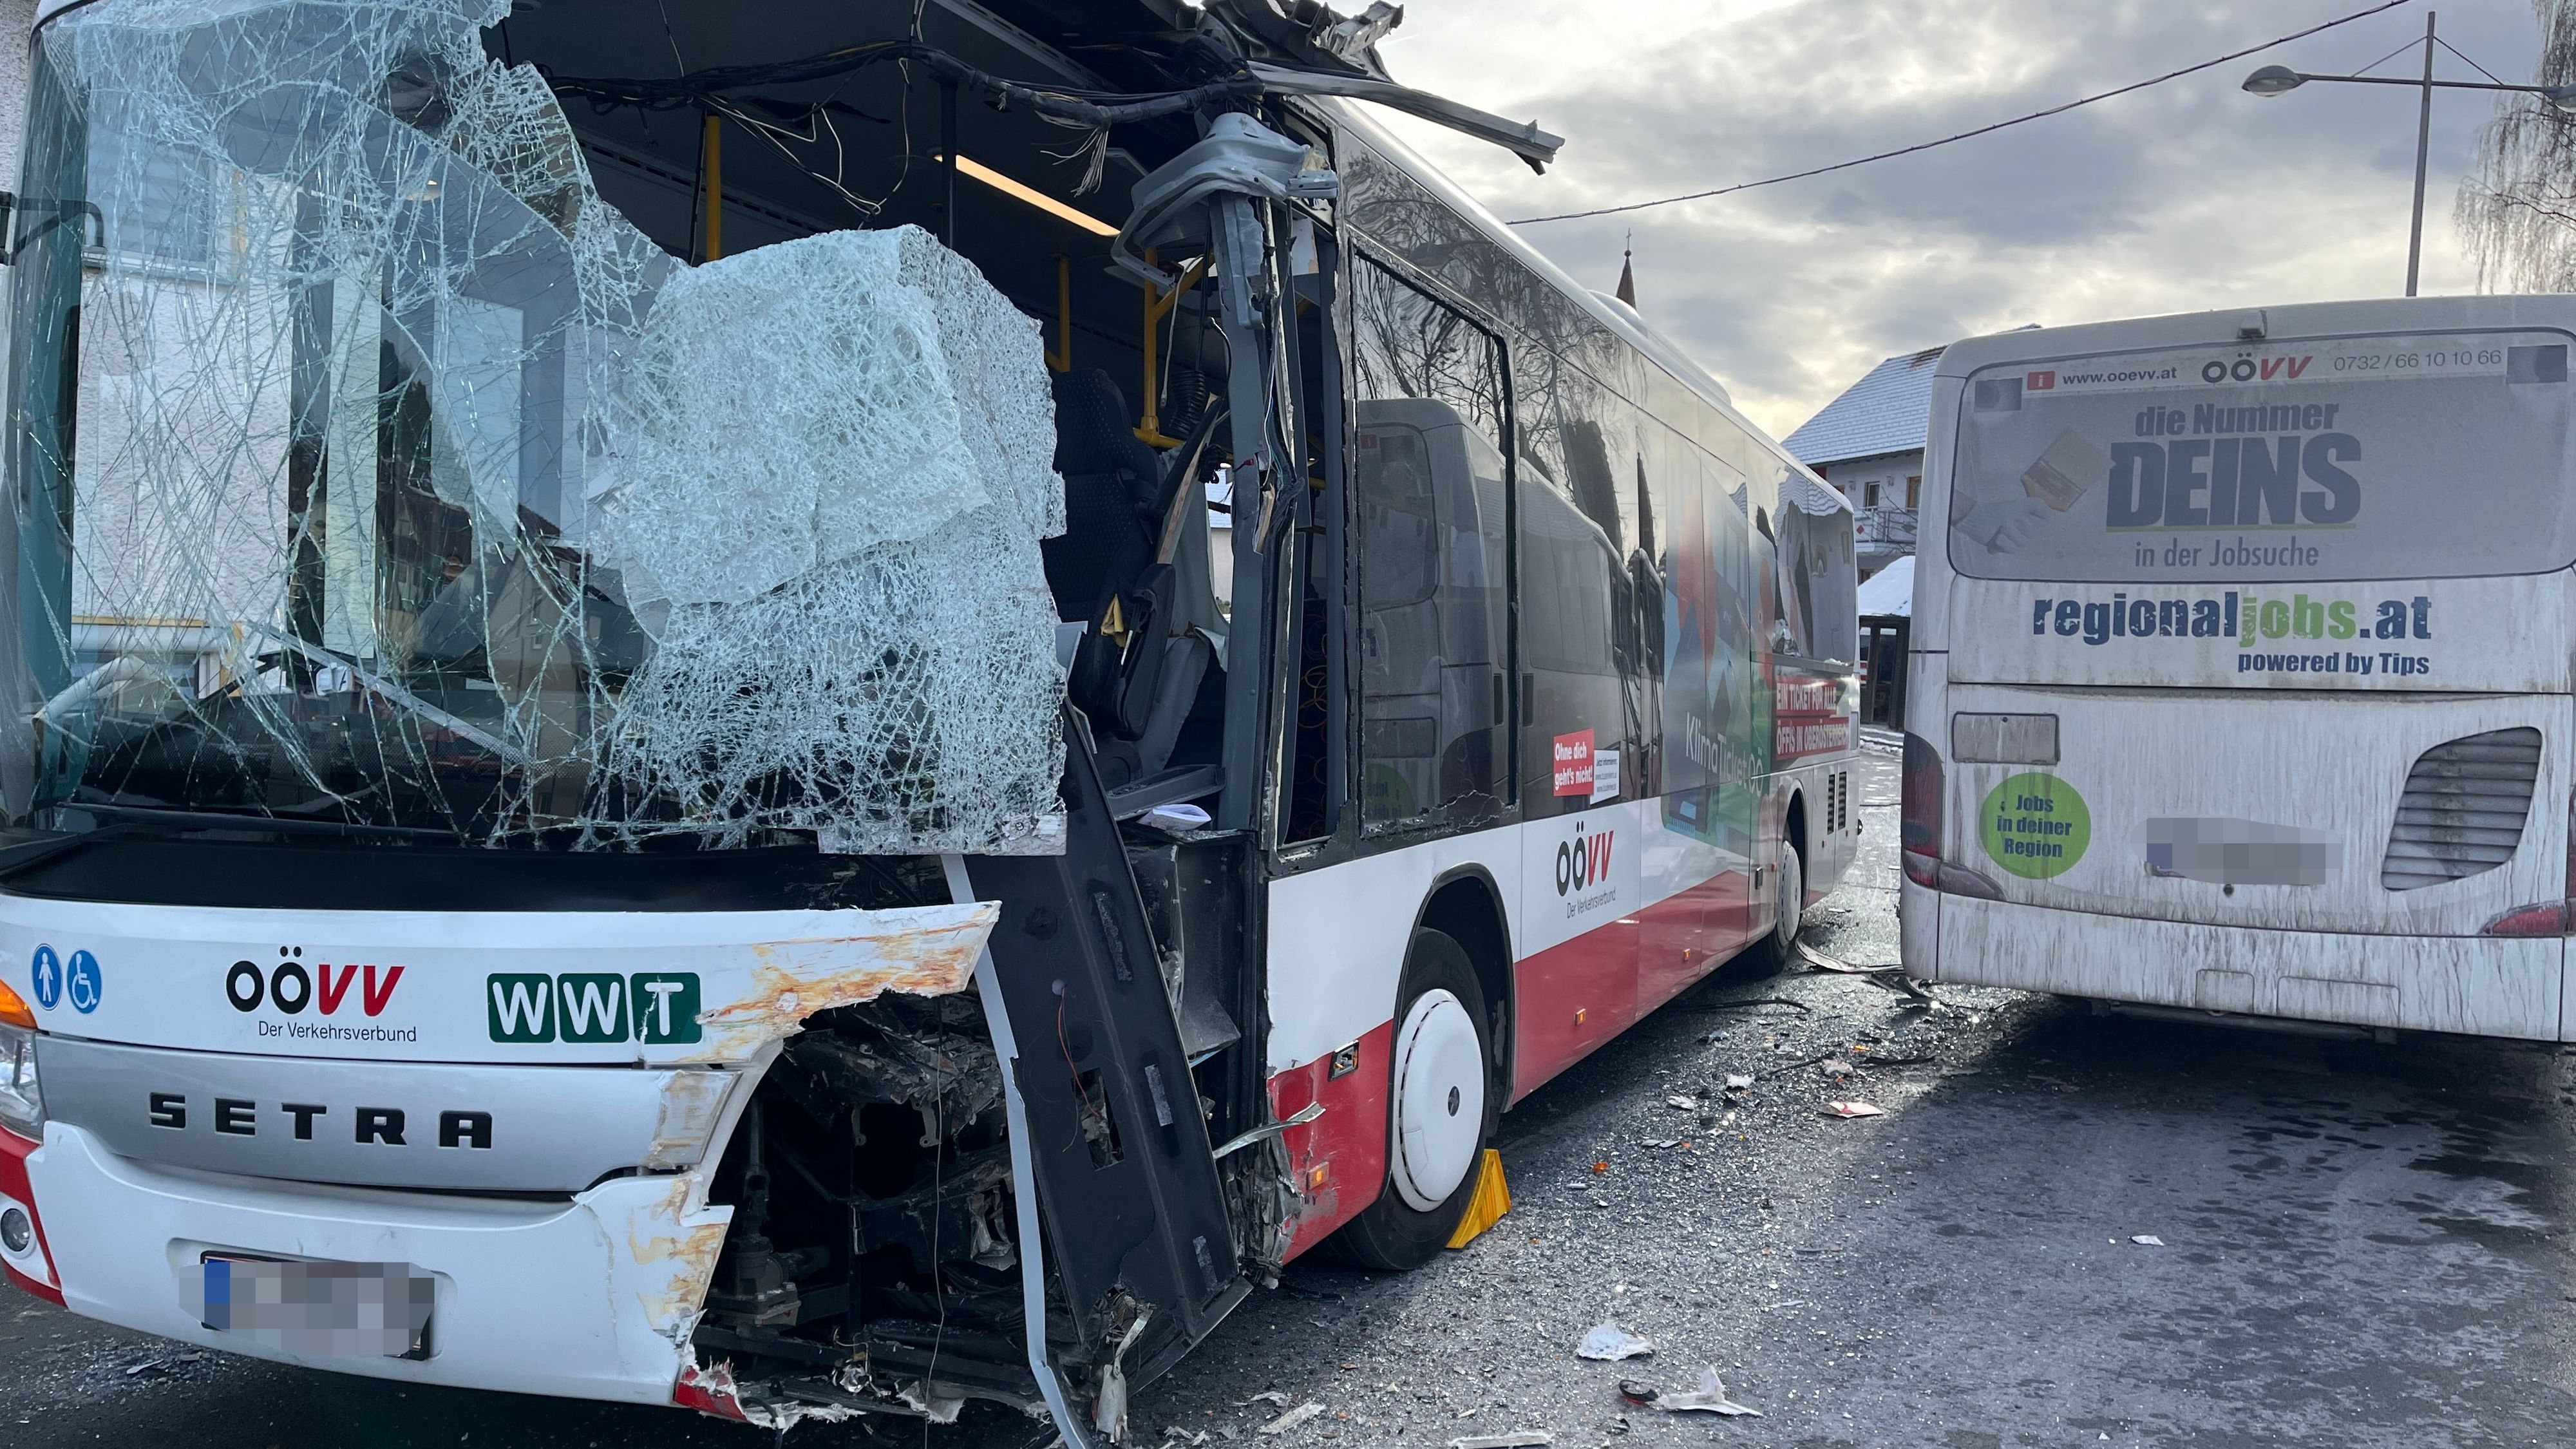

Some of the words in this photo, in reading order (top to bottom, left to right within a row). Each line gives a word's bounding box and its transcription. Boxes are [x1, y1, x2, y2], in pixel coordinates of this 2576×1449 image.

[2063, 366, 2177, 384] www.ooevv.at
[2201, 352, 2313, 383] OÖVV
[2334, 355, 2381, 372] 0732
[2395, 354, 2420, 368] 66
[2425, 352, 2445, 366] 10
[2453, 351, 2472, 366] 10
[2477, 350, 2502, 365] 66
[2135, 406, 2186, 437] die
[2193, 402, 2339, 435] Nummer
[2107, 432, 2362, 527] DEINS
[2135, 541, 2155, 567] in
[2164, 537, 2202, 567] der
[2209, 535, 2319, 567] Jobsuche
[2033, 591, 2432, 648] regionaljobs.at
[2238, 652, 2340, 673] powered
[2345, 652, 2374, 676] by
[2379, 652, 2430, 676] Tips
[1777, 682, 1788, 710] EIN
[1789, 683, 1812, 710] TICKET
[1555, 742, 1573, 761] Ohne
[1573, 741, 1587, 759] dich
[1555, 767, 1575, 791] geht's
[1575, 764, 1593, 784] nicht!
[2016, 794, 2054, 813] Jobs
[1997, 815, 2012, 832] in
[2016, 817, 2072, 836] deiner
[1556, 820, 1614, 897] OÖVV
[2004, 838, 2062, 858] Region
[1566, 902, 1576, 919] Der
[226, 945, 406, 1017] OÖVV
[492, 981, 684, 1036] WWT
[259, 1021, 283, 1037] Der
[287, 1021, 416, 1042] Verkehrsverbund
[149, 1092, 492, 1150] SETRA
